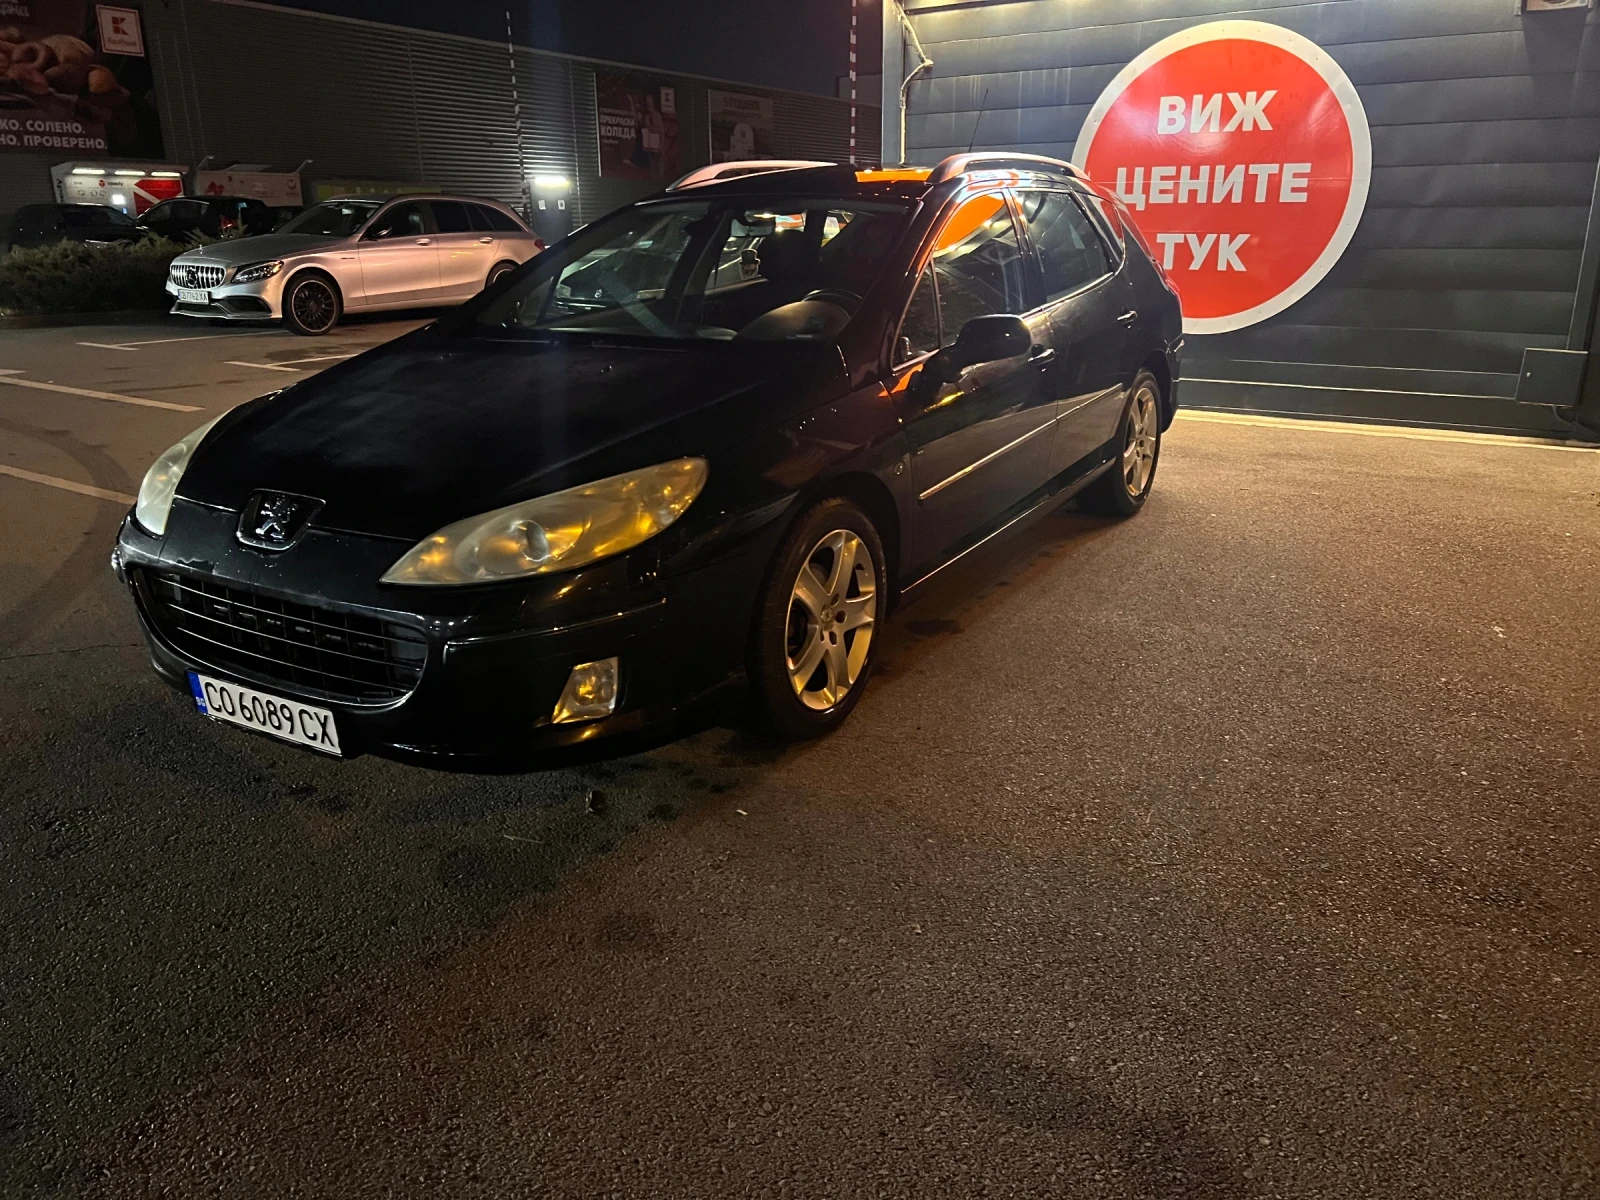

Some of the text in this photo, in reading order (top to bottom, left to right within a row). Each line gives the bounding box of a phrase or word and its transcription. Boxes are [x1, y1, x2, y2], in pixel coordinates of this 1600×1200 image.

[1158, 90, 1277, 134] ВИЖ
[26, 120, 86, 134] СОЛЕНО.
[600, 126, 636, 140] КОЛЕДА
[23, 135, 108, 149] ПРОВЕРЕНО.
[1117, 163, 1311, 210] ЦЕНИТЕ
[1156, 233, 1251, 272] ТУК
